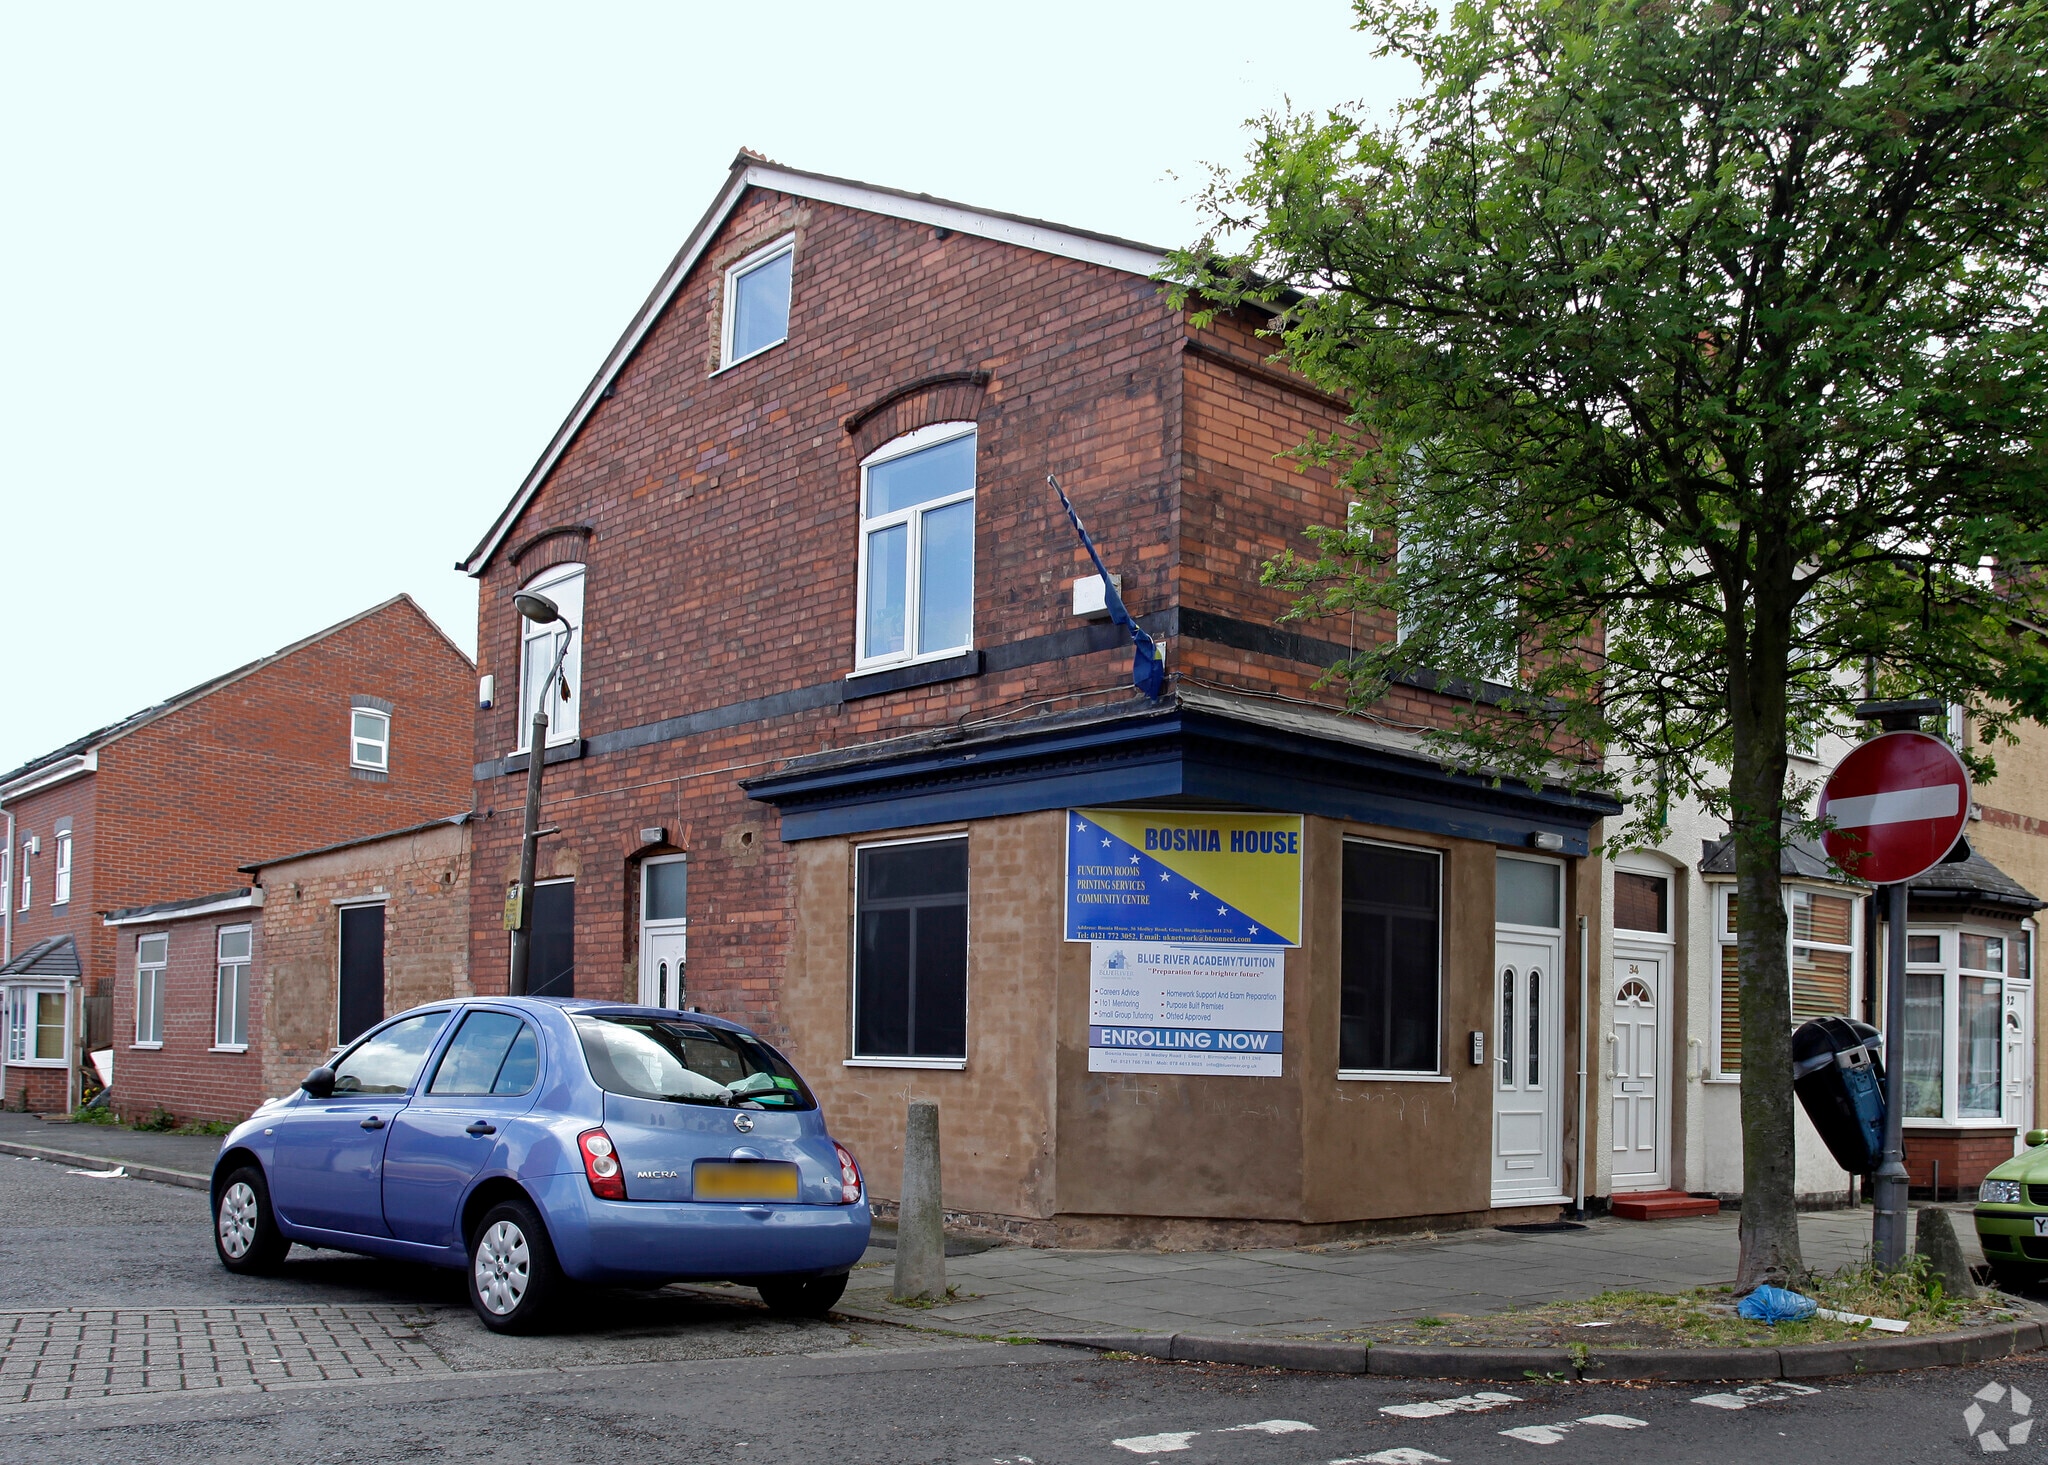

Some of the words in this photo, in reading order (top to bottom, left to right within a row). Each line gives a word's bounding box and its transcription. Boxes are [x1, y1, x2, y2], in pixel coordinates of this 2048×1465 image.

[1145, 828, 1221, 852] BOSNIA
[1231, 830, 1298, 854] HOUSE
[1077, 865, 1113, 875] FUNCTION
[1114, 866, 1140, 876] ROOMS
[1077, 879, 1111, 889] PRINTING
[1111, 880, 1146, 891] SERVICES
[1076, 894, 1120, 904] COMMUNITY
[1121, 894, 1150, 905] CENTRE
[1163, 934, 1251, 943] uknetwork@btconnect.com
[1137, 953, 1160, 964] BLUE
[1163, 954, 1190, 965] RIVER
[1193, 955, 1275, 968] ACADEMY/TUITION
[1629, 964, 1639, 974] 34
[1100, 988, 1120, 996] Careers
[1121, 988, 1140, 996] Advice
[1166, 989, 1195, 998] Homework
[1196, 990, 1217, 999] Support
[1217, 991, 1229, 999] And
[1245, 992, 1277, 1001] Preparation
[1112, 1000, 1140, 1009] Mentoring
[1166, 1001, 1187, 1009] Purpose
[1189, 1001, 1200, 1009] Built
[1201, 1002, 1224, 1010] Premises
[1114, 1011, 1131, 1019] Group
[1132, 1011, 1154, 1021] Tutoring
[1166, 1012, 1184, 1020] Ofsted
[1184, 1012, 1211, 1021] Approved
[1101, 1029, 1212, 1048] ENROLLING
[1218, 1033, 1269, 1050] NOW
[637, 1170, 677, 1179] MICRA
